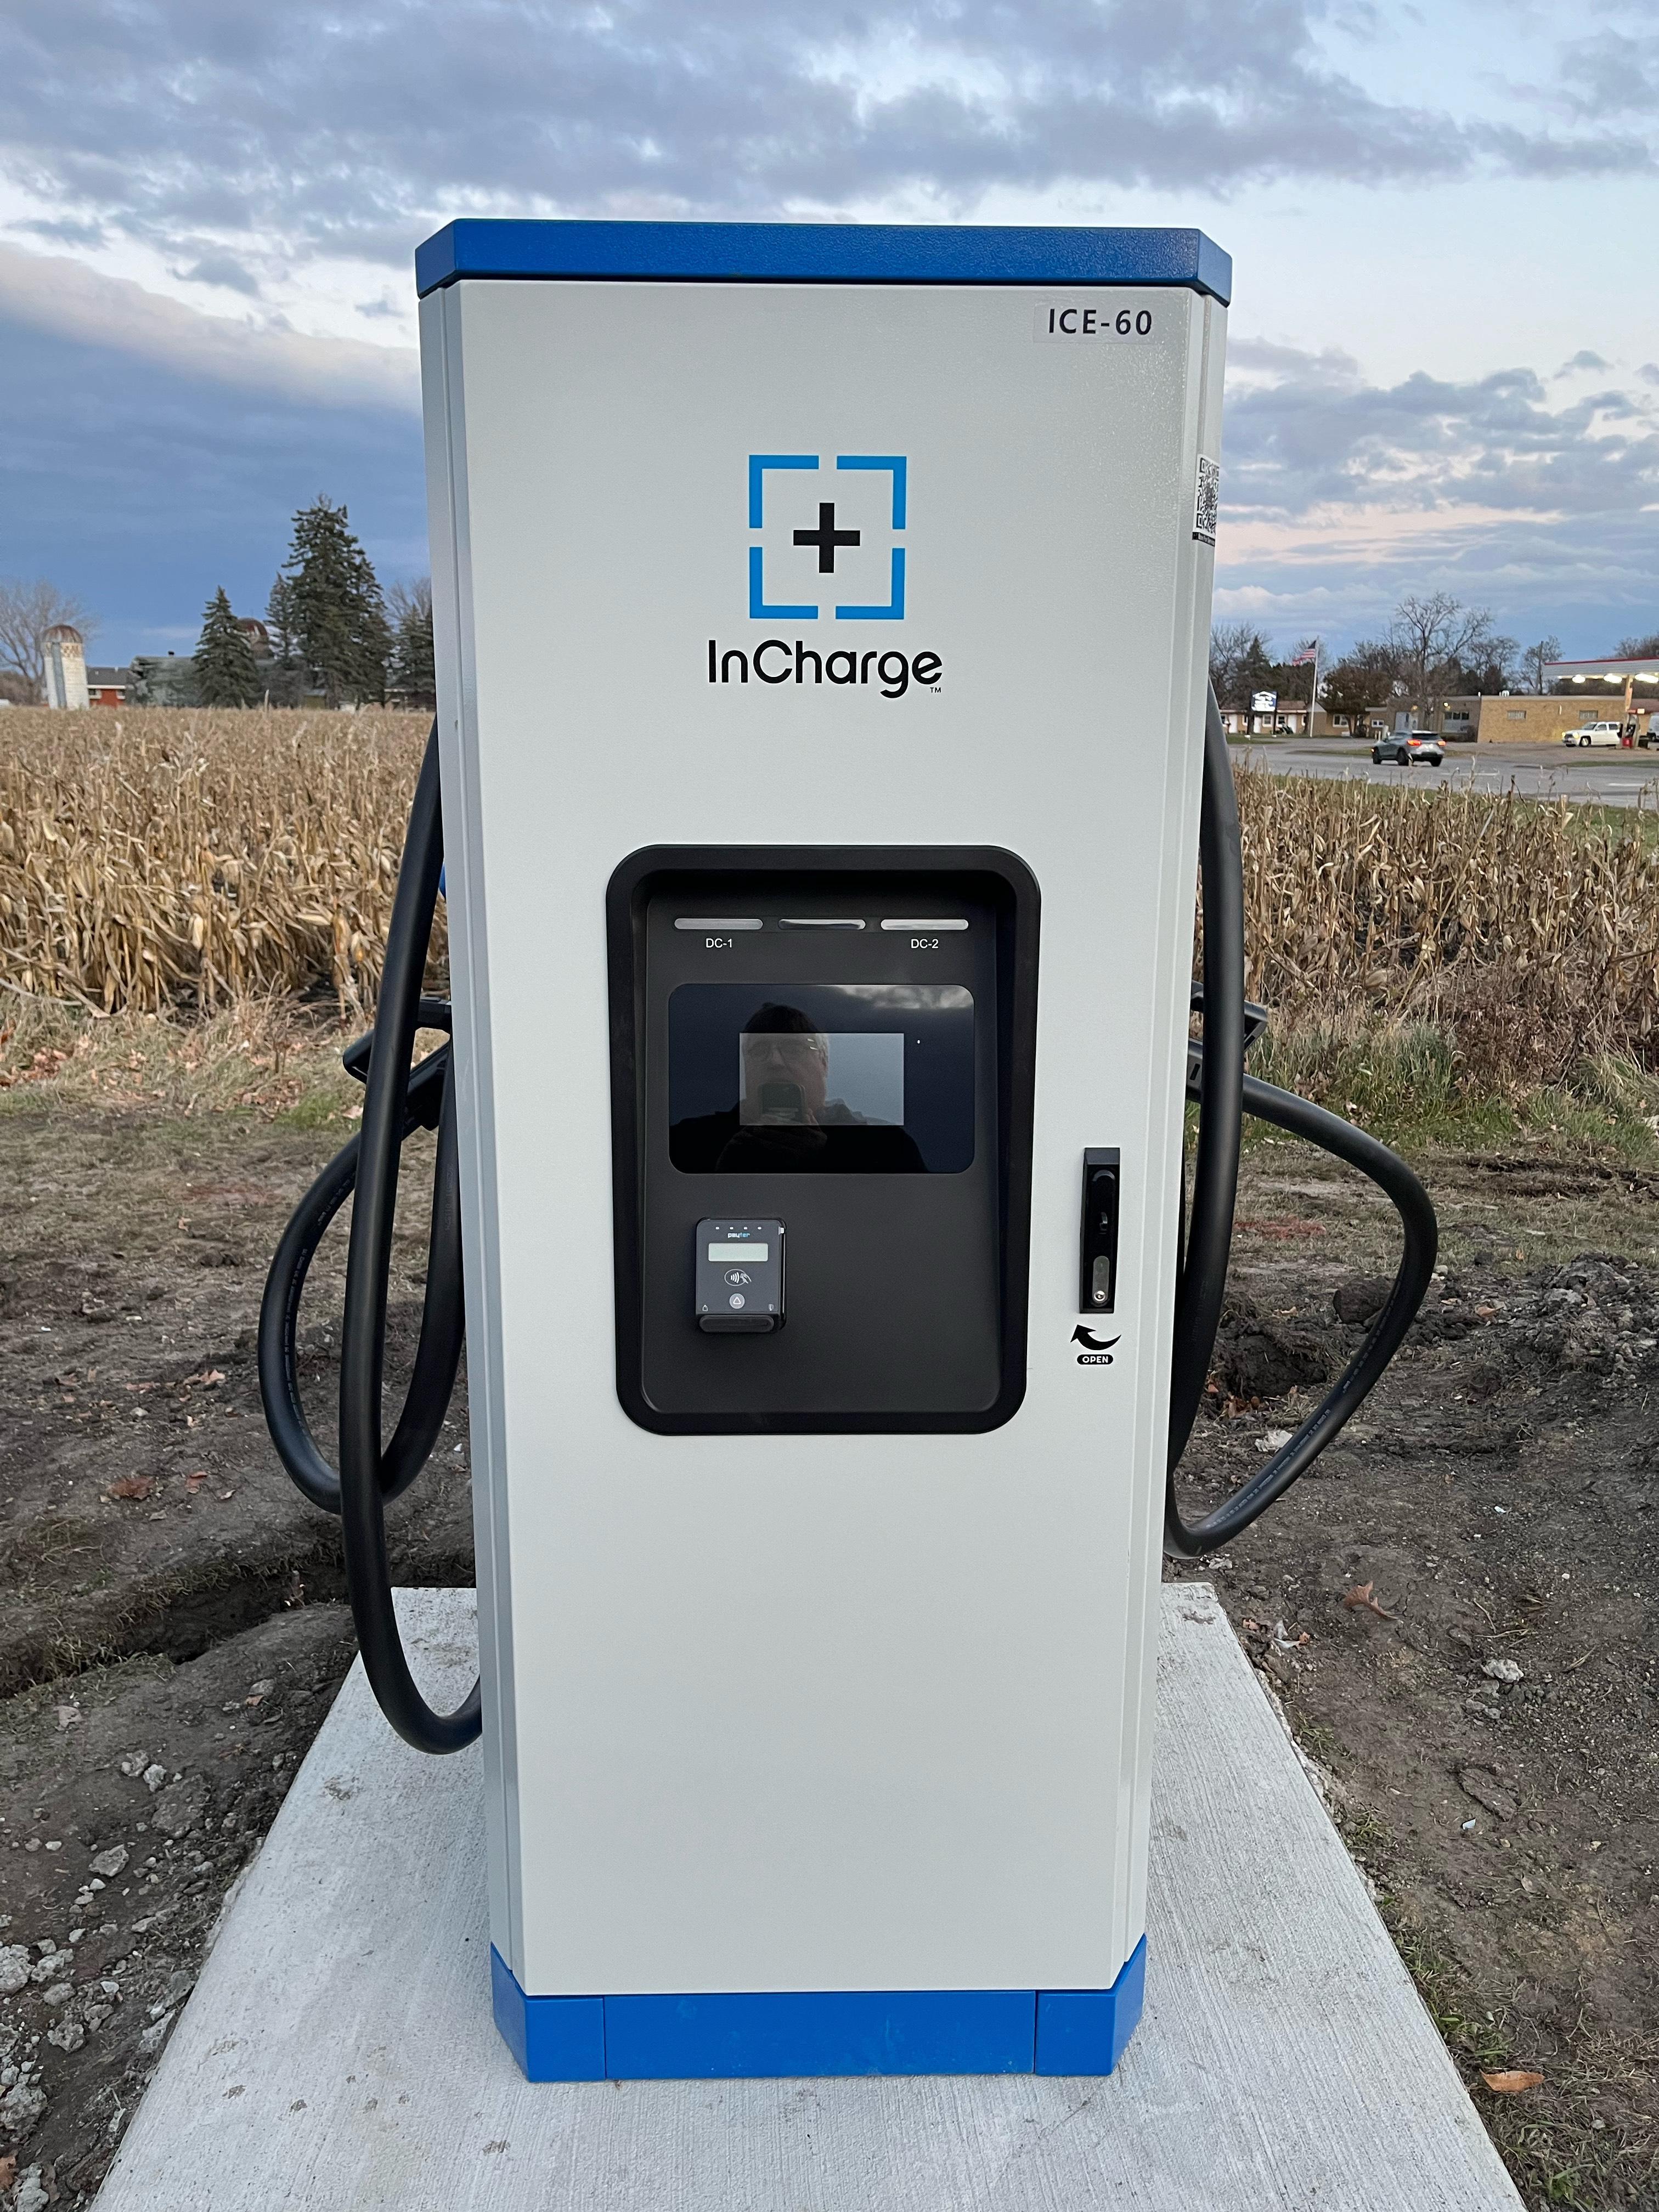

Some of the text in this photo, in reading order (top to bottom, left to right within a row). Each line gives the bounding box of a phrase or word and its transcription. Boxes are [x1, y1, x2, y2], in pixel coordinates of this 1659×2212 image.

[1048, 308, 1153, 336] ICE-60
[708, 639, 943, 698] InCharge
[706, 938, 732, 949] DC-1
[910, 938, 939, 949] DC-2
